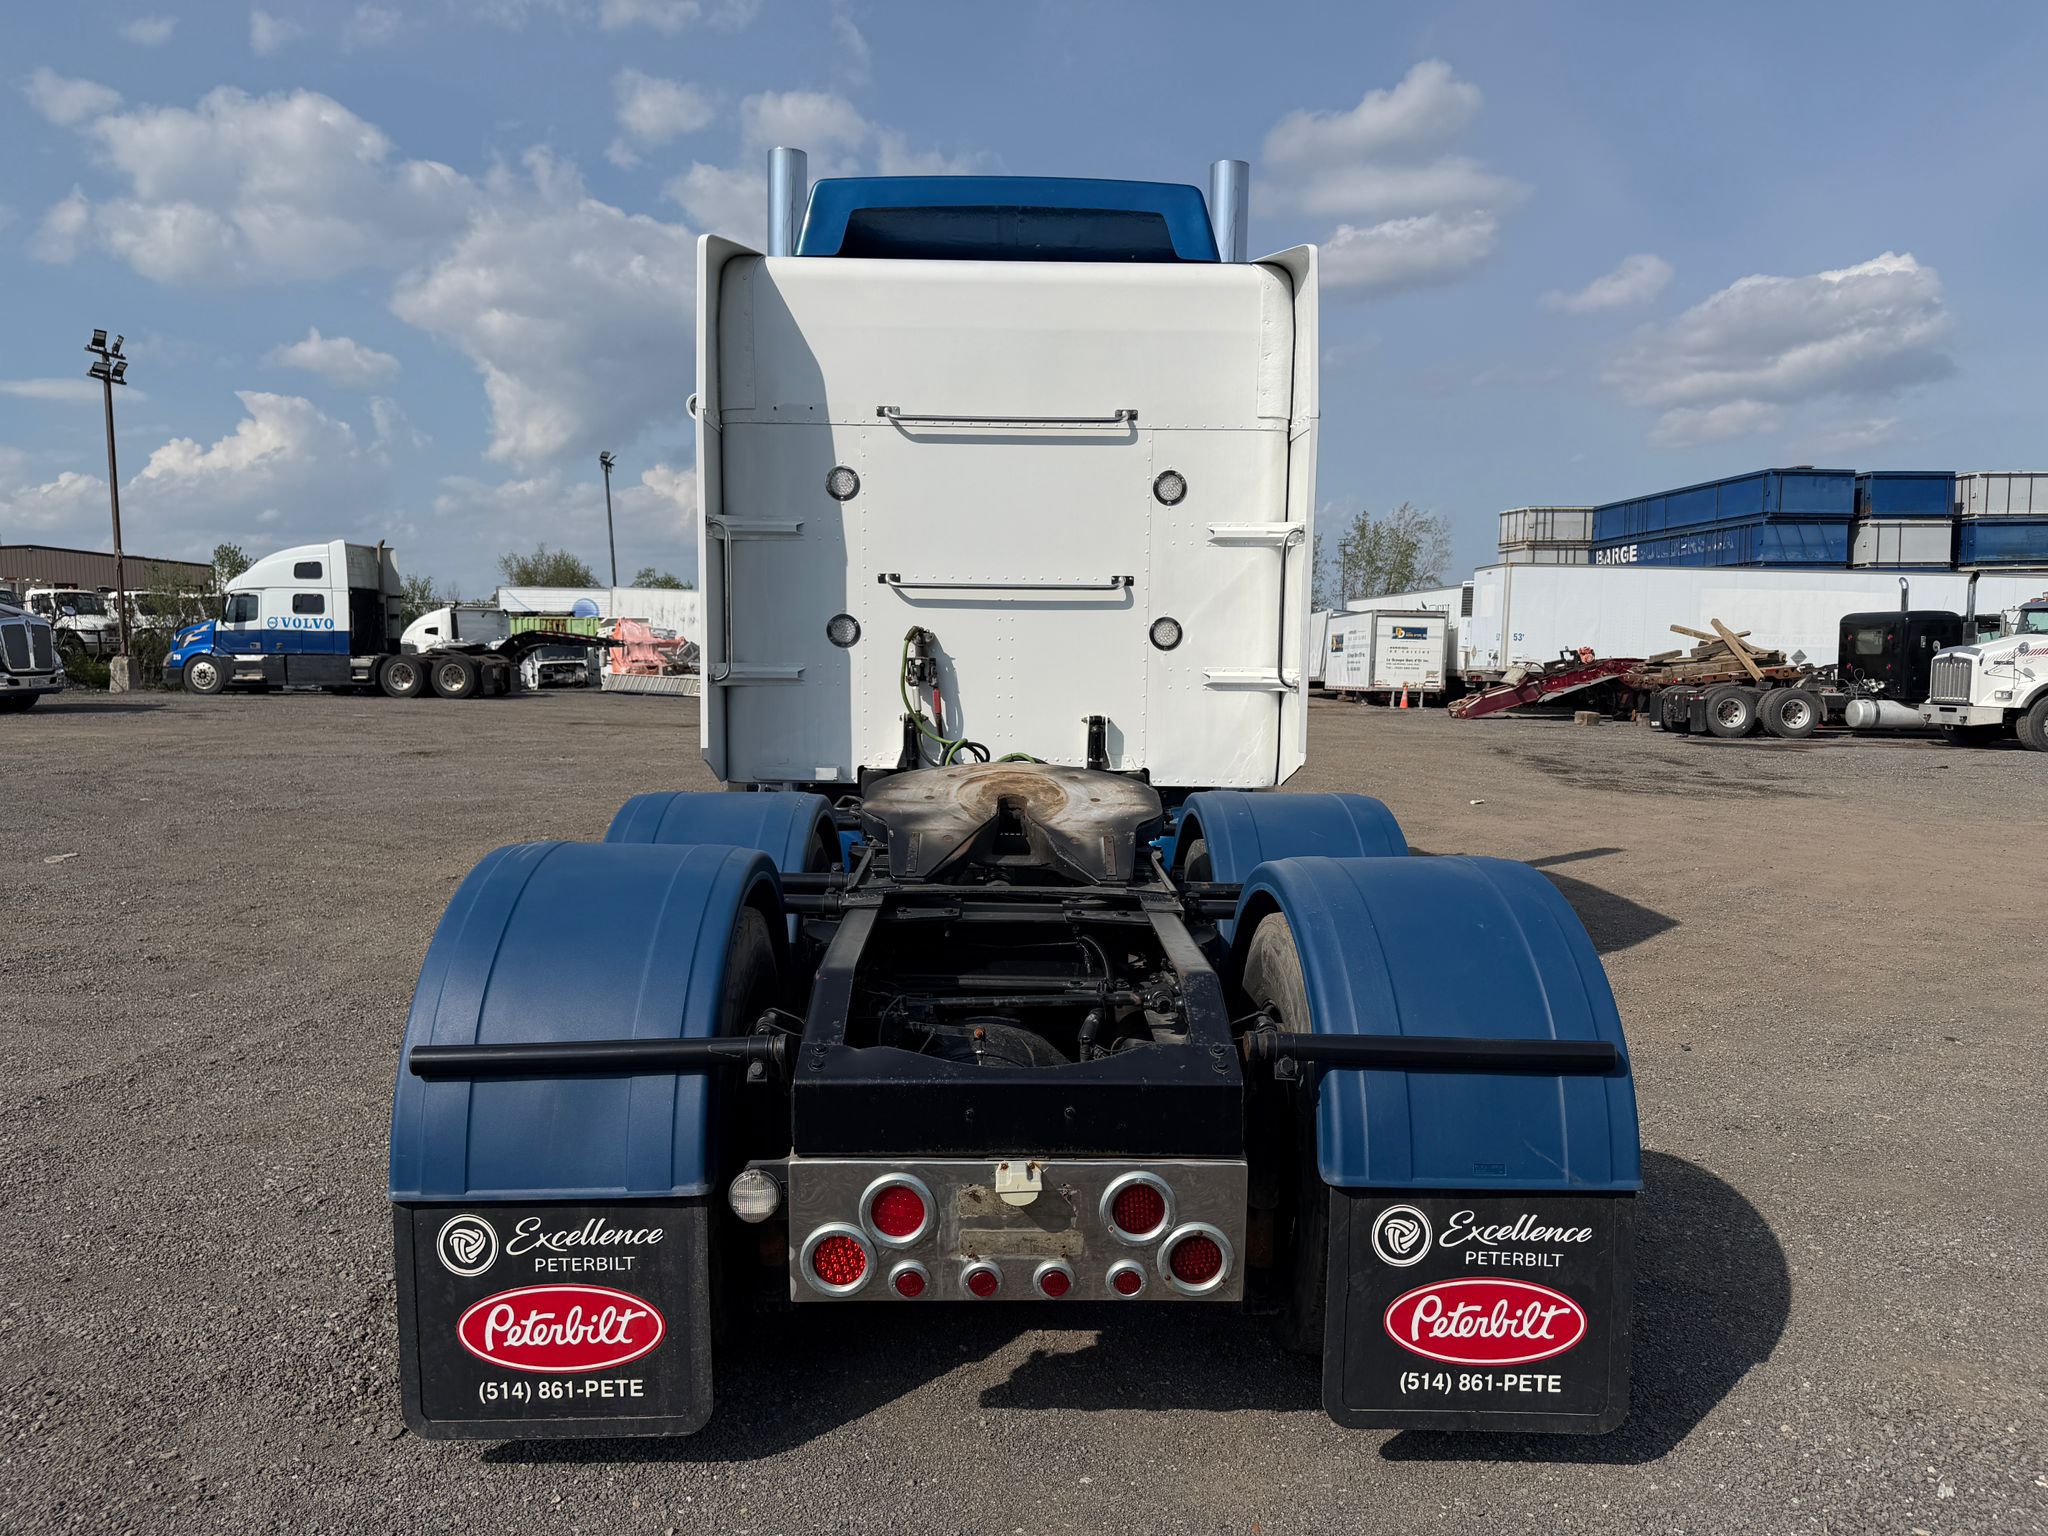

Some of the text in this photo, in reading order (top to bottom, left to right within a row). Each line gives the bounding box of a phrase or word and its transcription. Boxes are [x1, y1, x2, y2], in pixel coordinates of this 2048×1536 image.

[1595, 544, 1638, 565] BARGE
[281, 616, 334, 630] VOLVO
[505, 1216, 664, 1256] Excellence
[1439, 1210, 1593, 1248] Excellence
[534, 1256, 636, 1273] PETERBILT
[1465, 1251, 1564, 1268] PETERBILT
[484, 1303, 647, 1352] Peterbilt
[1411, 1294, 1571, 1341] Peterbilt
[478, 1379, 644, 1403] (514) 861-PETE
[1400, 1372, 1562, 1394] (514) 861-PETE
